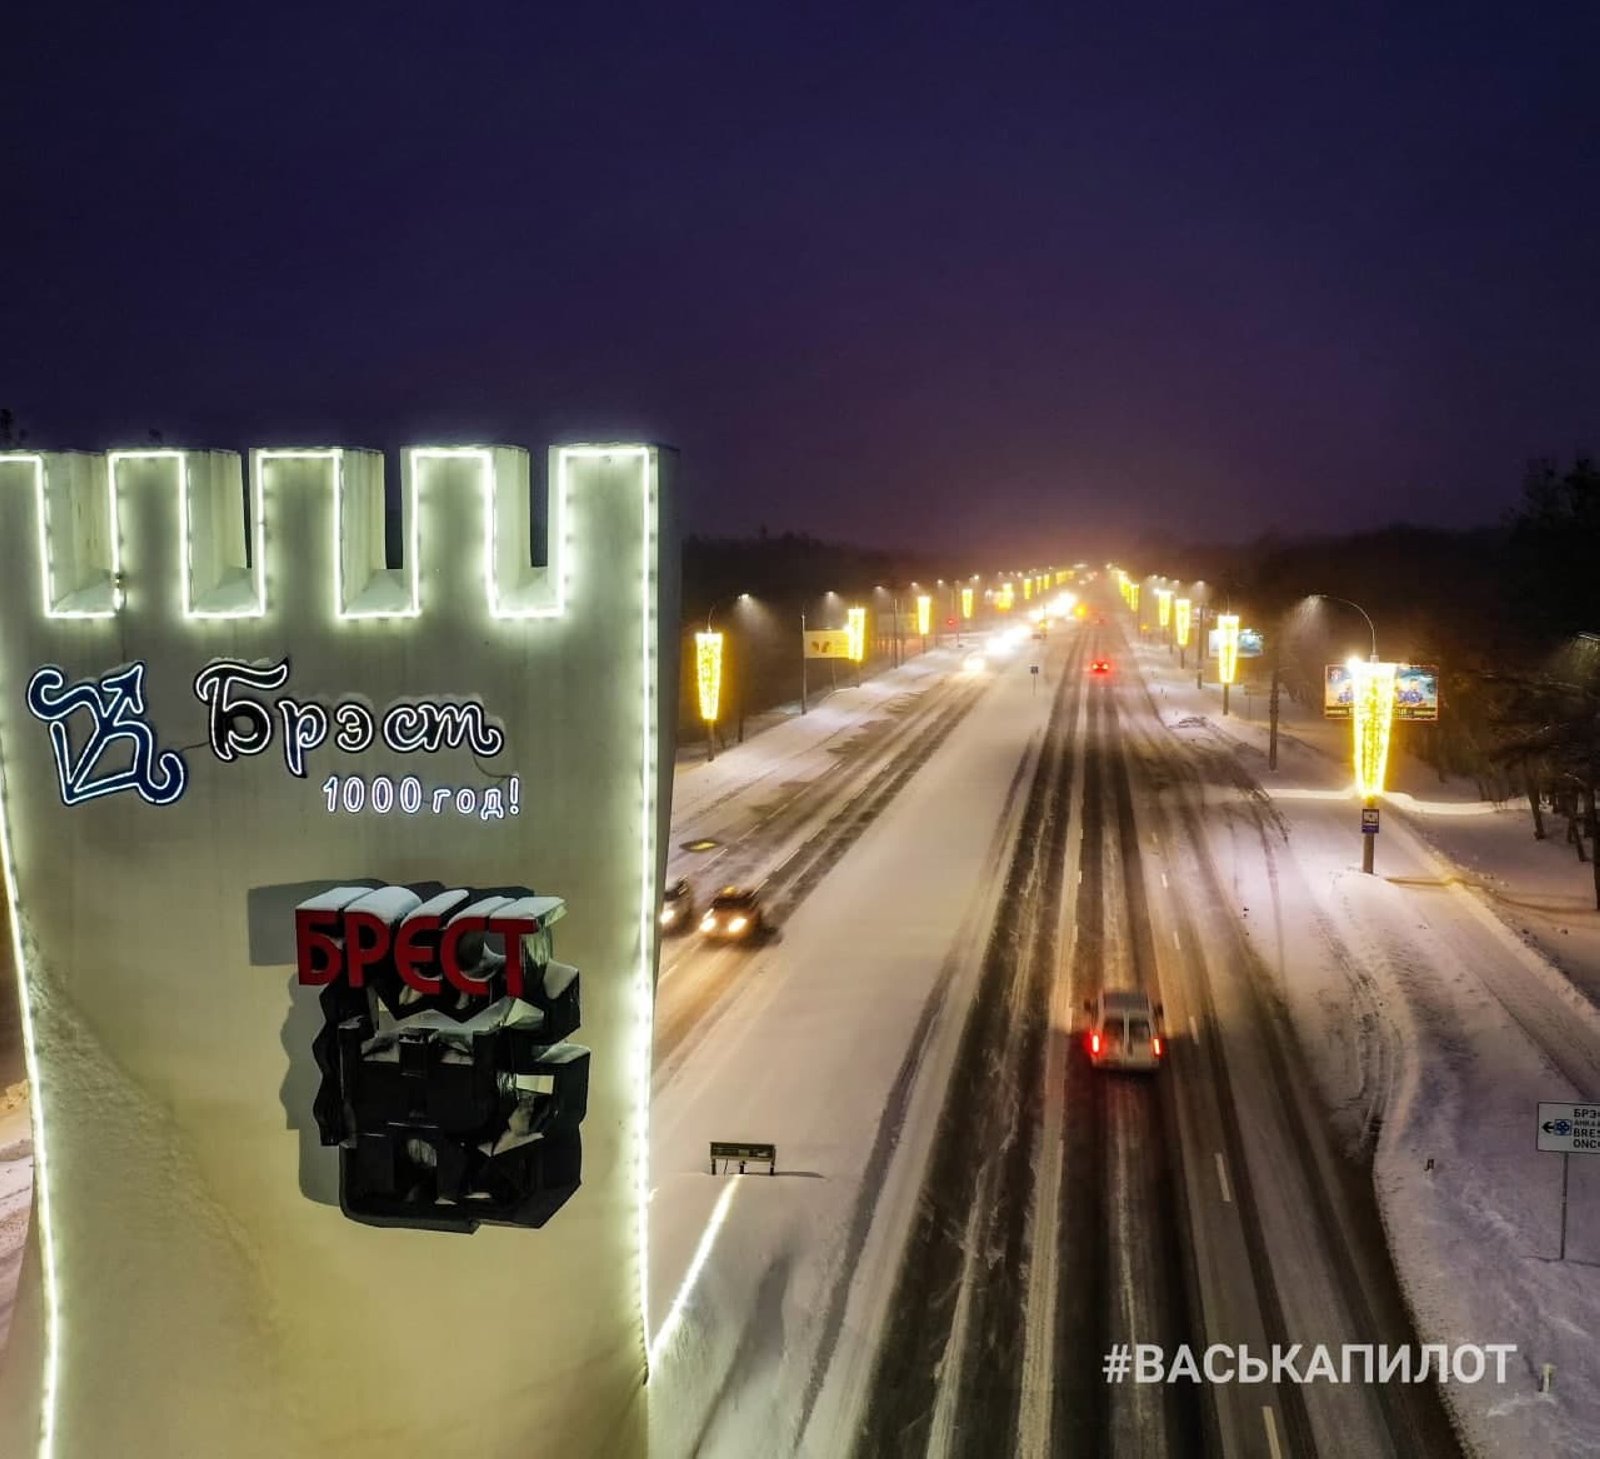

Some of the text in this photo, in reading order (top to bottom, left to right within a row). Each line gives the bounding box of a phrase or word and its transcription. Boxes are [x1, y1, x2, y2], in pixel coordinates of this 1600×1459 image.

[194, 656, 505, 778] Брэст
[322, 775, 520, 820] 1000 год!
[295, 908, 539, 999] БРЕСТ
